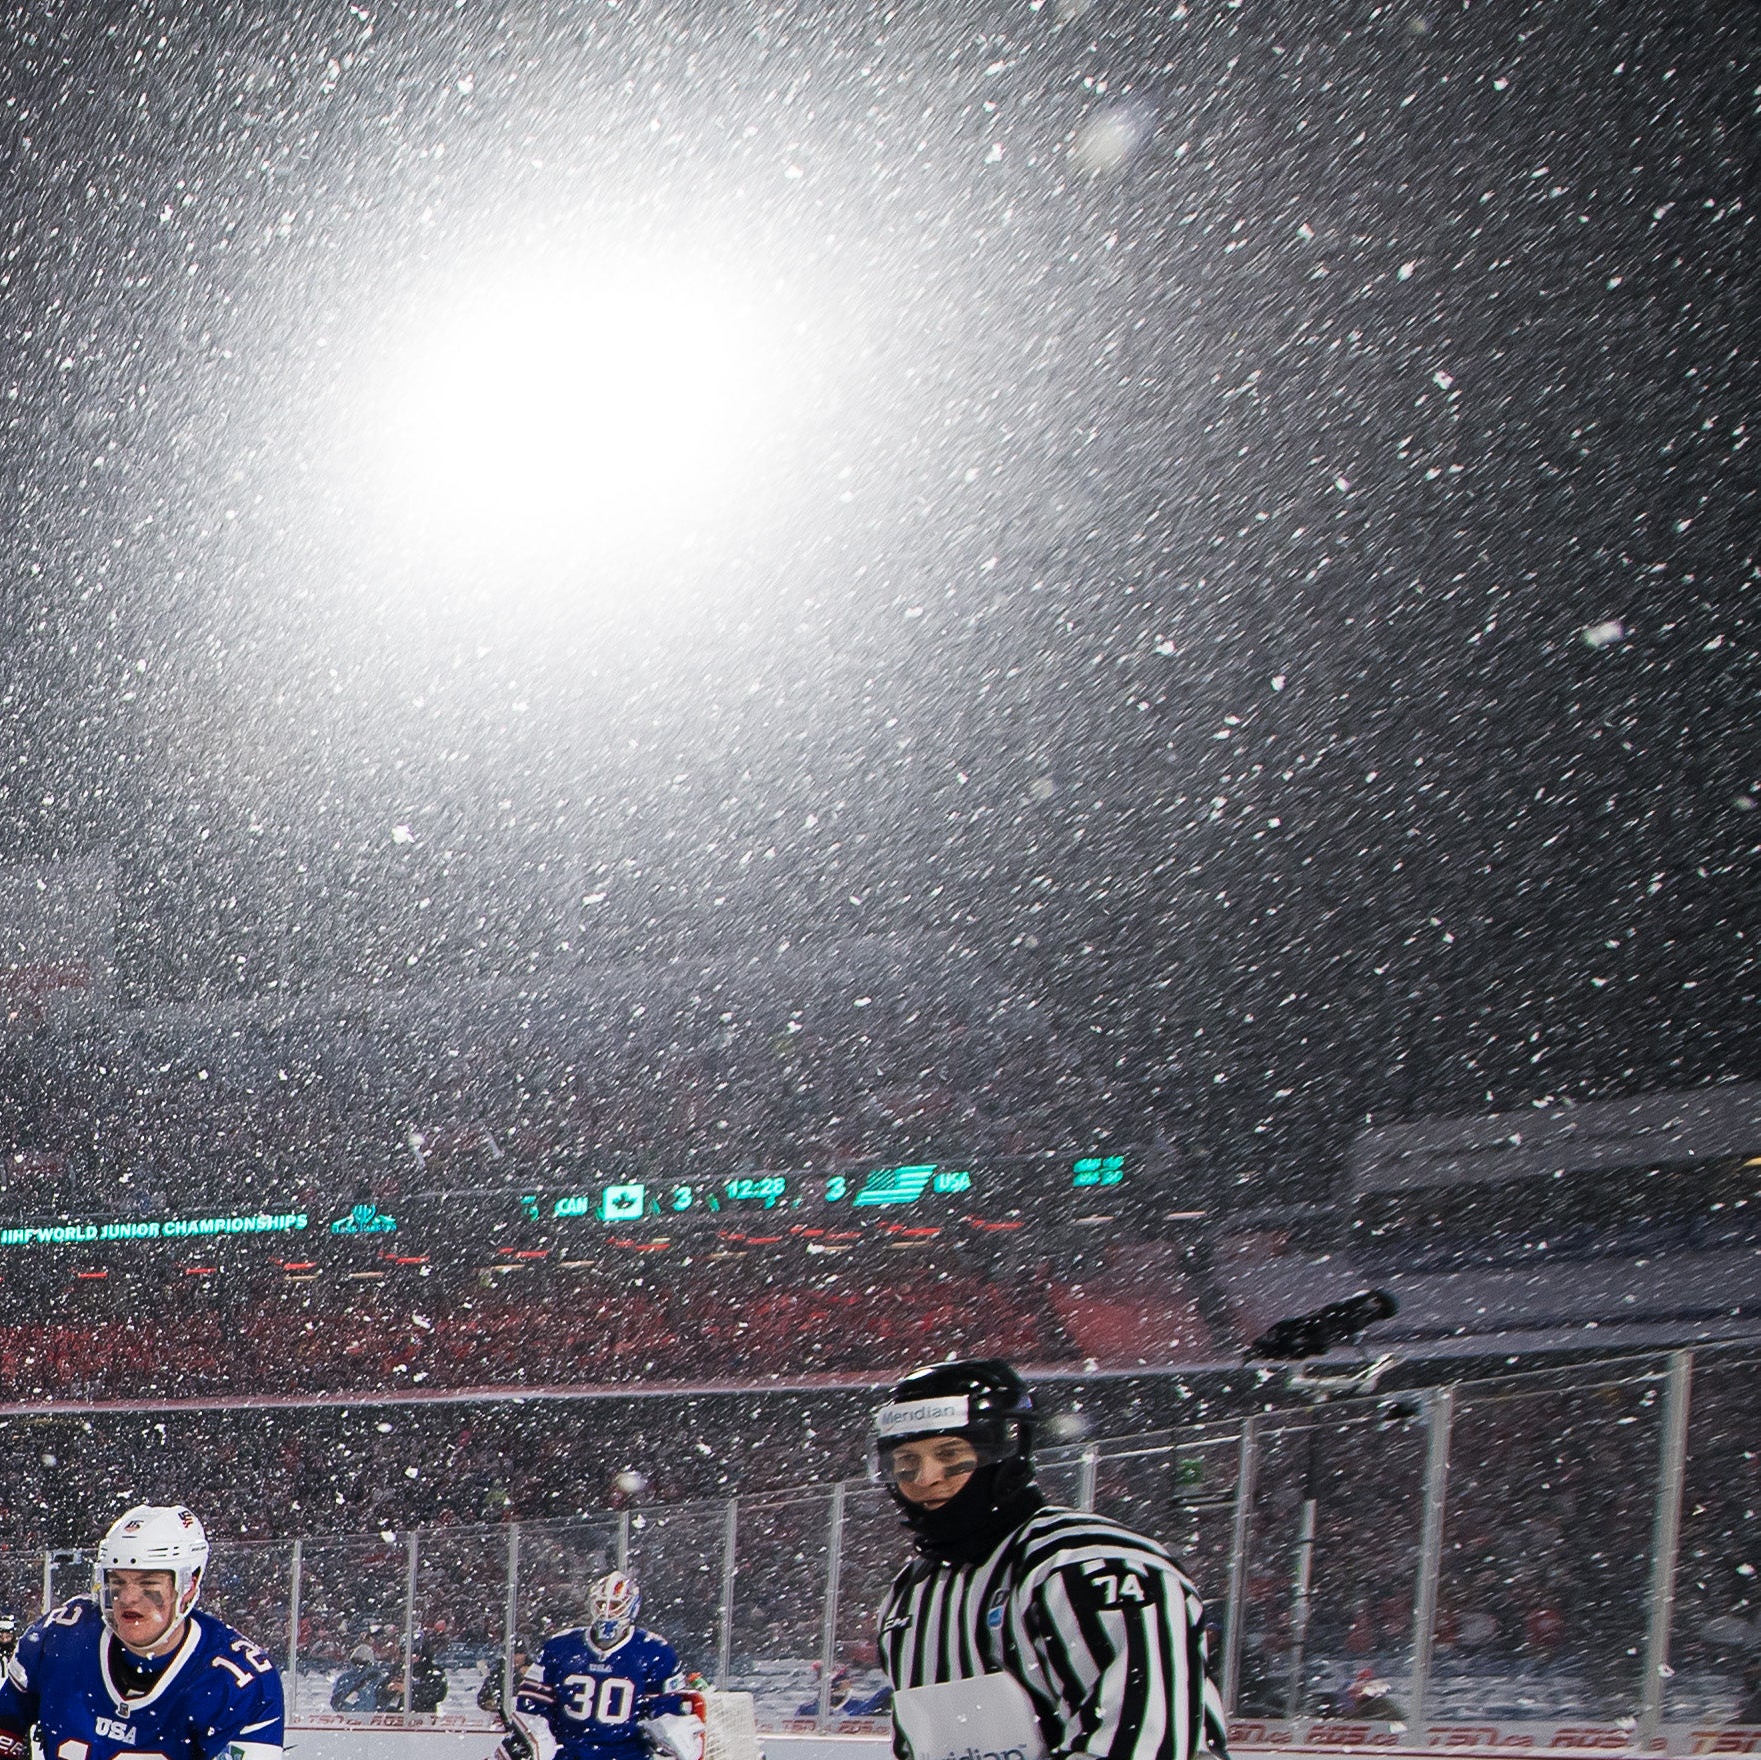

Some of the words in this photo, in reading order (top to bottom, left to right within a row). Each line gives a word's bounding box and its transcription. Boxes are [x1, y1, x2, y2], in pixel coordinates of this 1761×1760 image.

[726, 1177, 785, 1199] 12:28
[826, 1177, 846, 1201] 3
[935, 1172, 971, 1194] USA
[554, 1197, 589, 1217] CAN
[673, 1186, 693, 1211] 3
[37, 1226, 98, 1243] WORLD
[100, 1221, 160, 1240] JUNIOR
[163, 1214, 308, 1237] CHAMPIONSHIPS
[881, 1404, 956, 1426] Meridian
[1090, 1572, 1146, 1605] 74
[211, 1638, 273, 1689] 12
[563, 1673, 636, 1725] 30
[95, 1716, 136, 1746] USA
[1229, 1722, 1292, 1745] SN.ca
